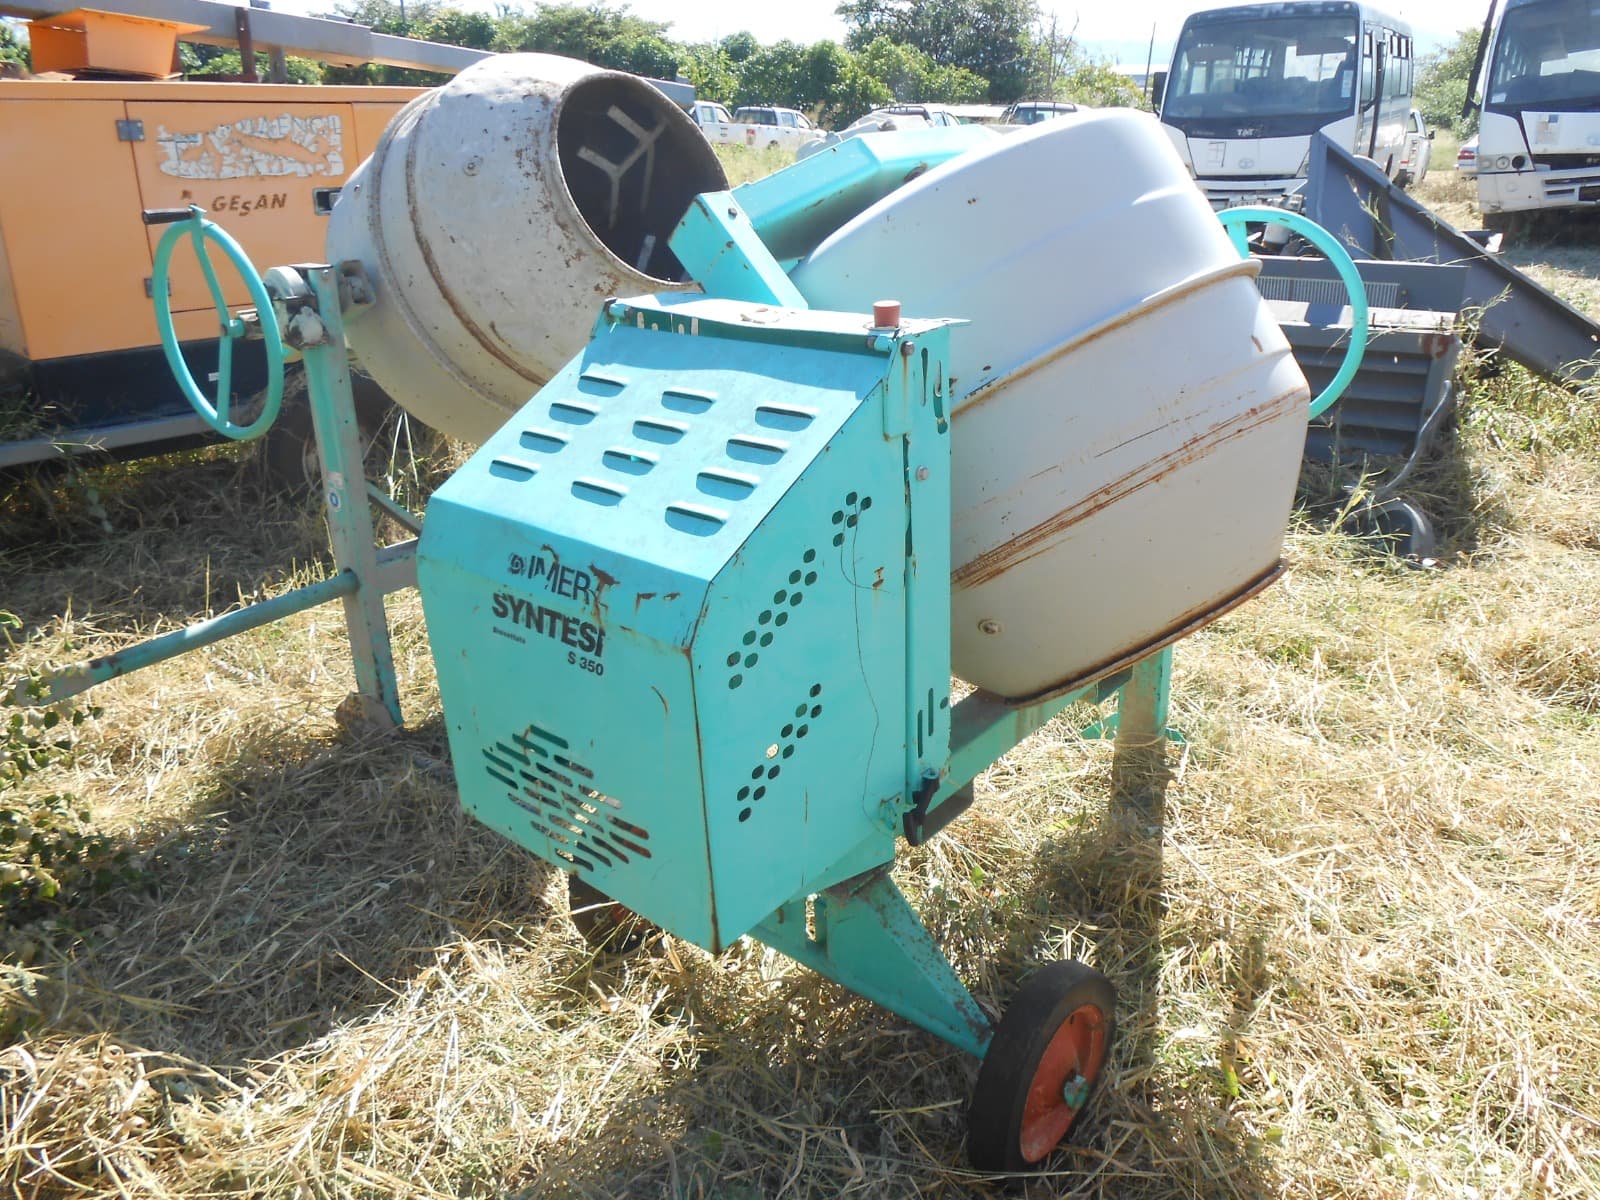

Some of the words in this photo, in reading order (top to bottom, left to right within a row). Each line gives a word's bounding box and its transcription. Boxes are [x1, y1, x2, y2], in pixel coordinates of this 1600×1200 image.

[211, 193, 287, 216] GESAN
[491, 592, 606, 657] SYNTESI
[567, 651, 577, 665] S
[579, 656, 604, 676] 350
